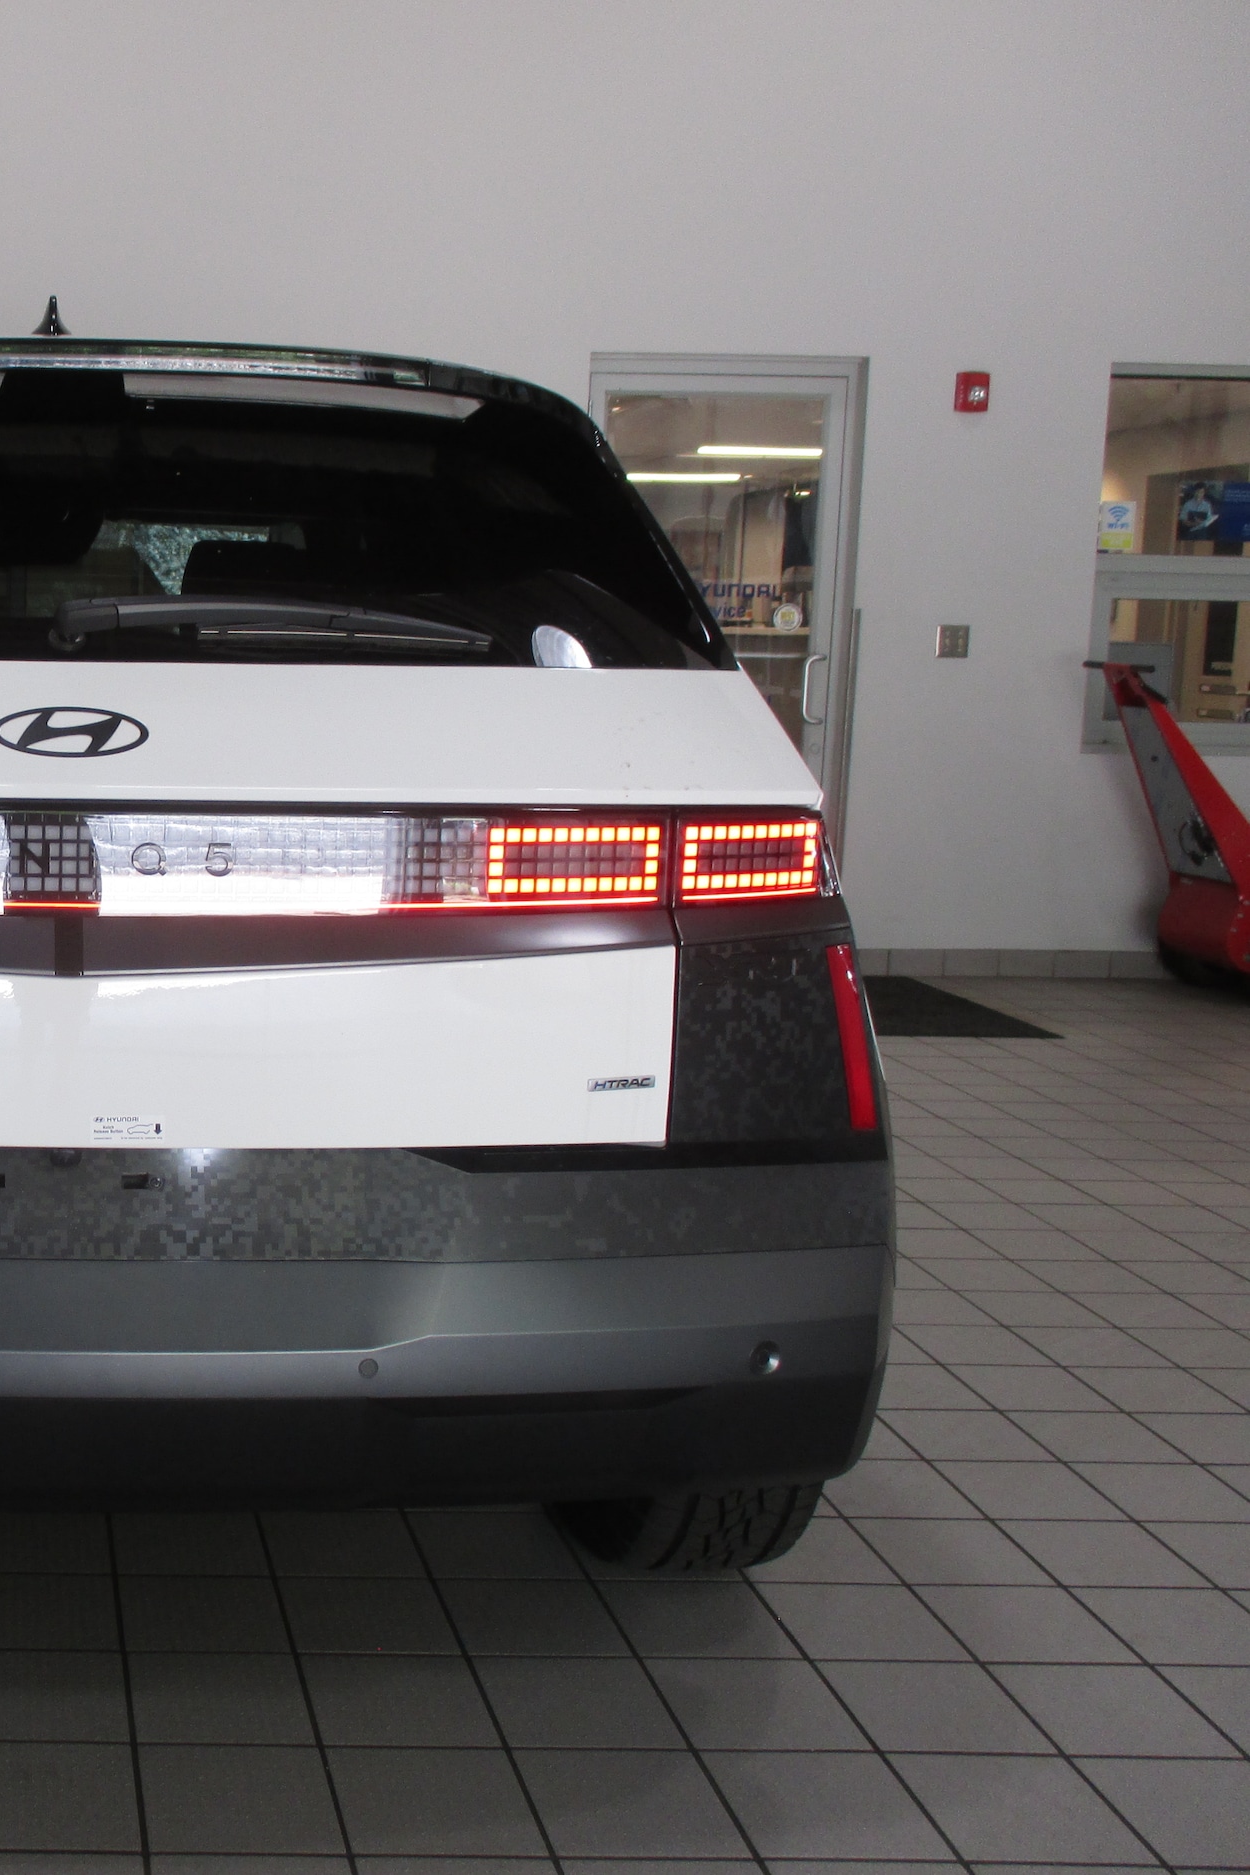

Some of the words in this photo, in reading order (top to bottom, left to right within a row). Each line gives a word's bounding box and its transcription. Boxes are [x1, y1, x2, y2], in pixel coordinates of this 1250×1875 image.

[699, 583, 778, 599] YUNDAI
[711, 602, 747, 618] vice
[205, 842, 235, 877] 5
[594, 1077, 650, 1089] HTRAC
